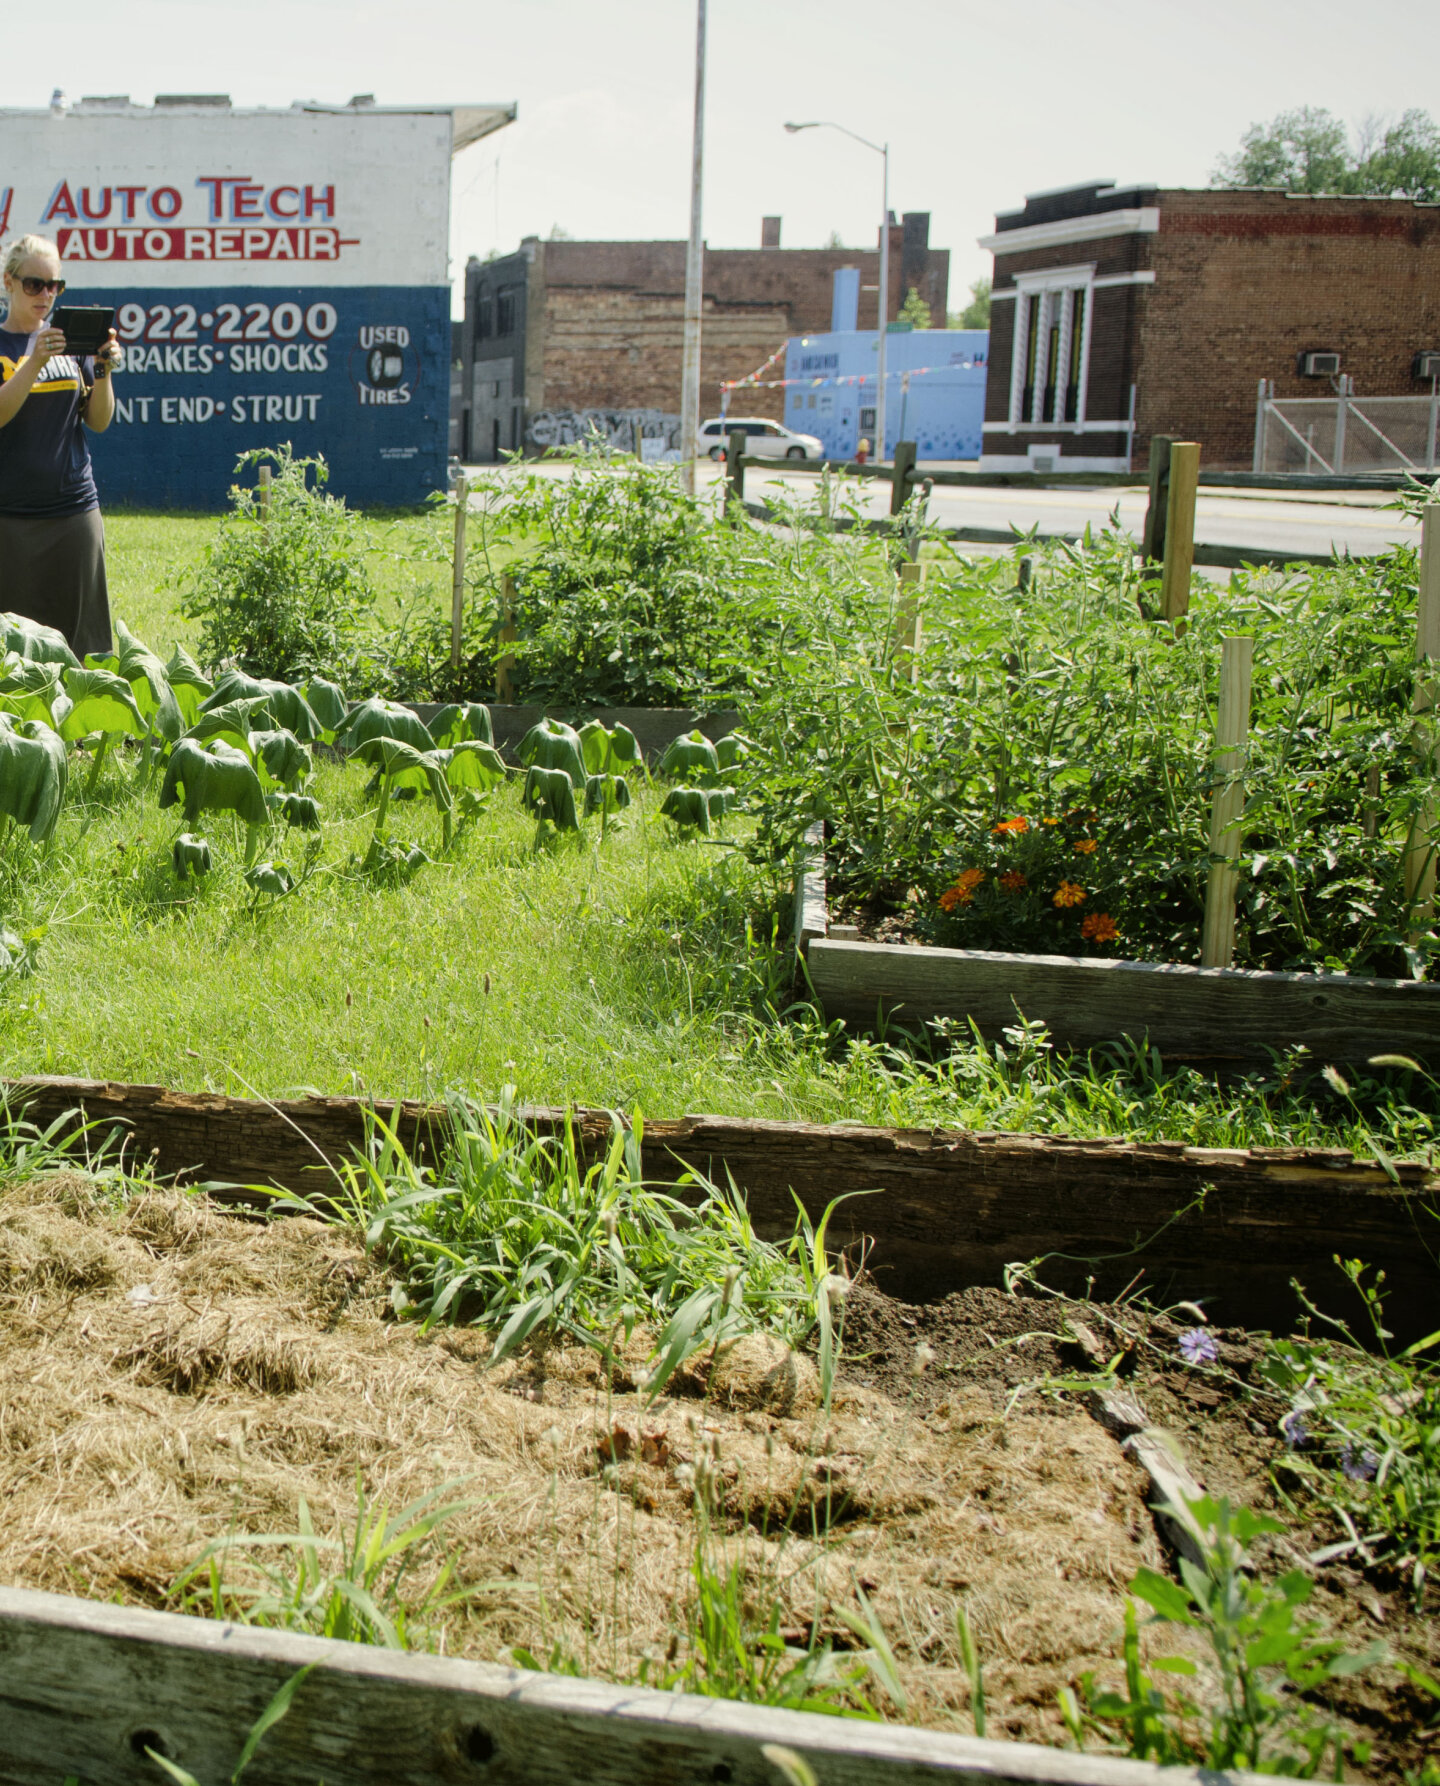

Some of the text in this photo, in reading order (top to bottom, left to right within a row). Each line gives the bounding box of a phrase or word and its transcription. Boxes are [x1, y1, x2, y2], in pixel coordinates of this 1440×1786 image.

[39, 176, 336, 224] AUTO TECH
[61, 229, 337, 260] AUTO REPAIR
[360, 326, 410, 349] USED
[229, 343, 328, 372] SHOCKS
[358, 382, 411, 404] TIRES
[161, 396, 214, 423] END
[231, 395, 322, 422] STRUT
